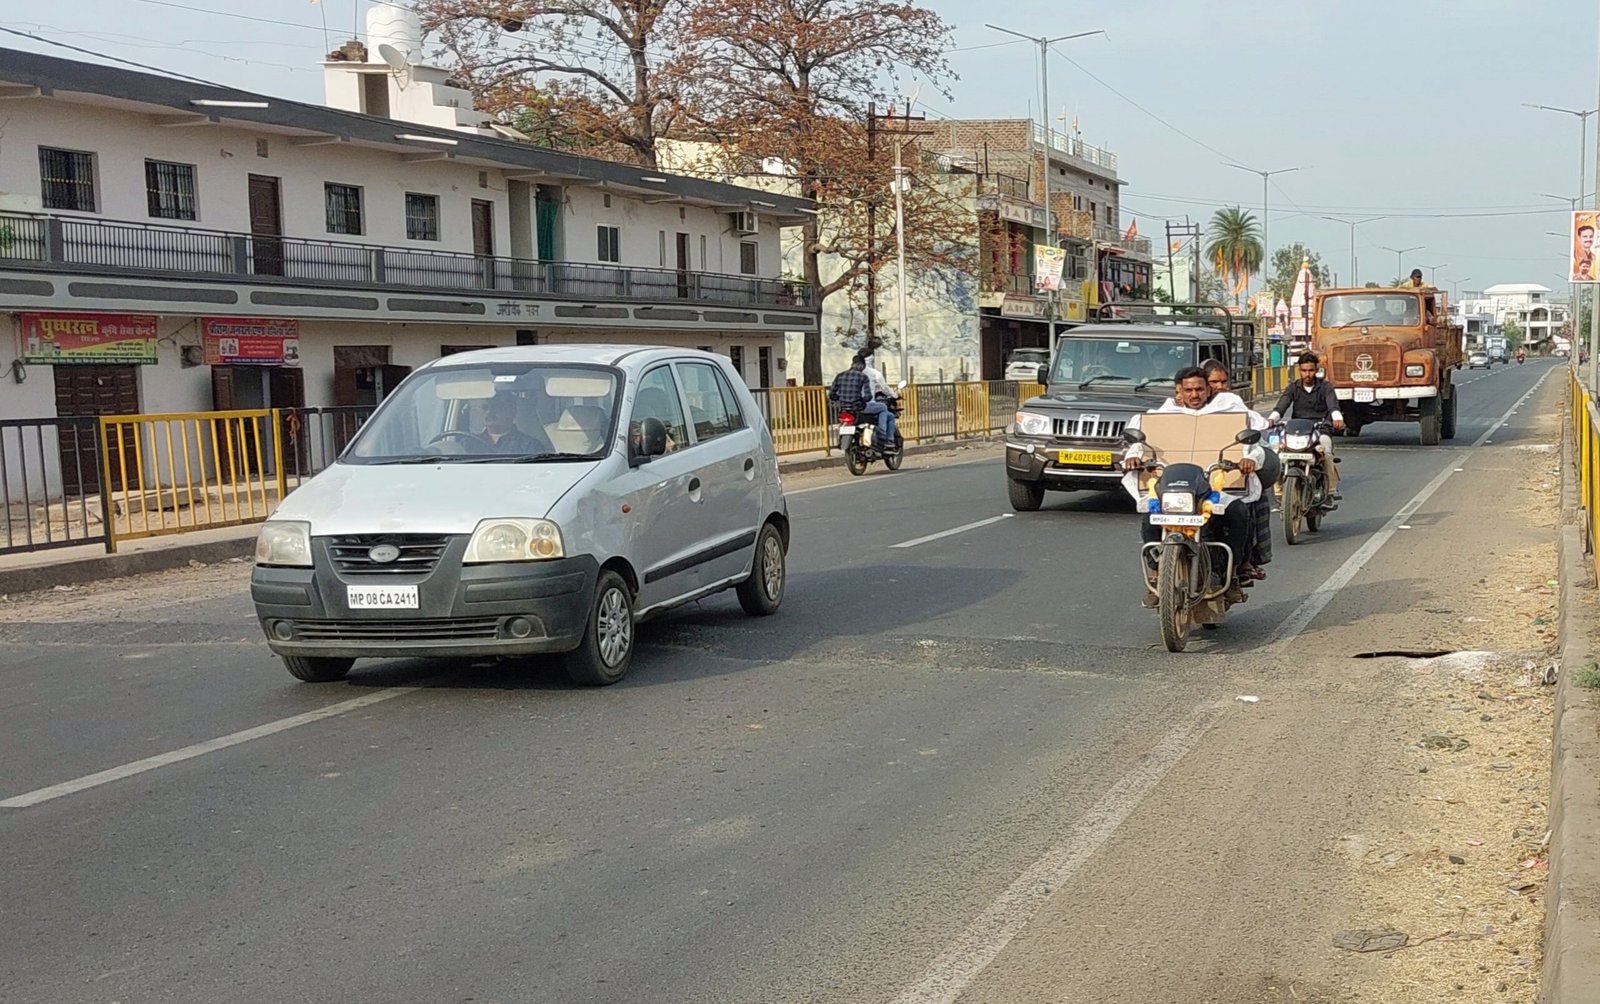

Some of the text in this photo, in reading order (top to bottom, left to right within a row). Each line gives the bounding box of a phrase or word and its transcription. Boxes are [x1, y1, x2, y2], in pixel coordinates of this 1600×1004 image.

[350, 593, 417, 606] MP 08 CA 2411
